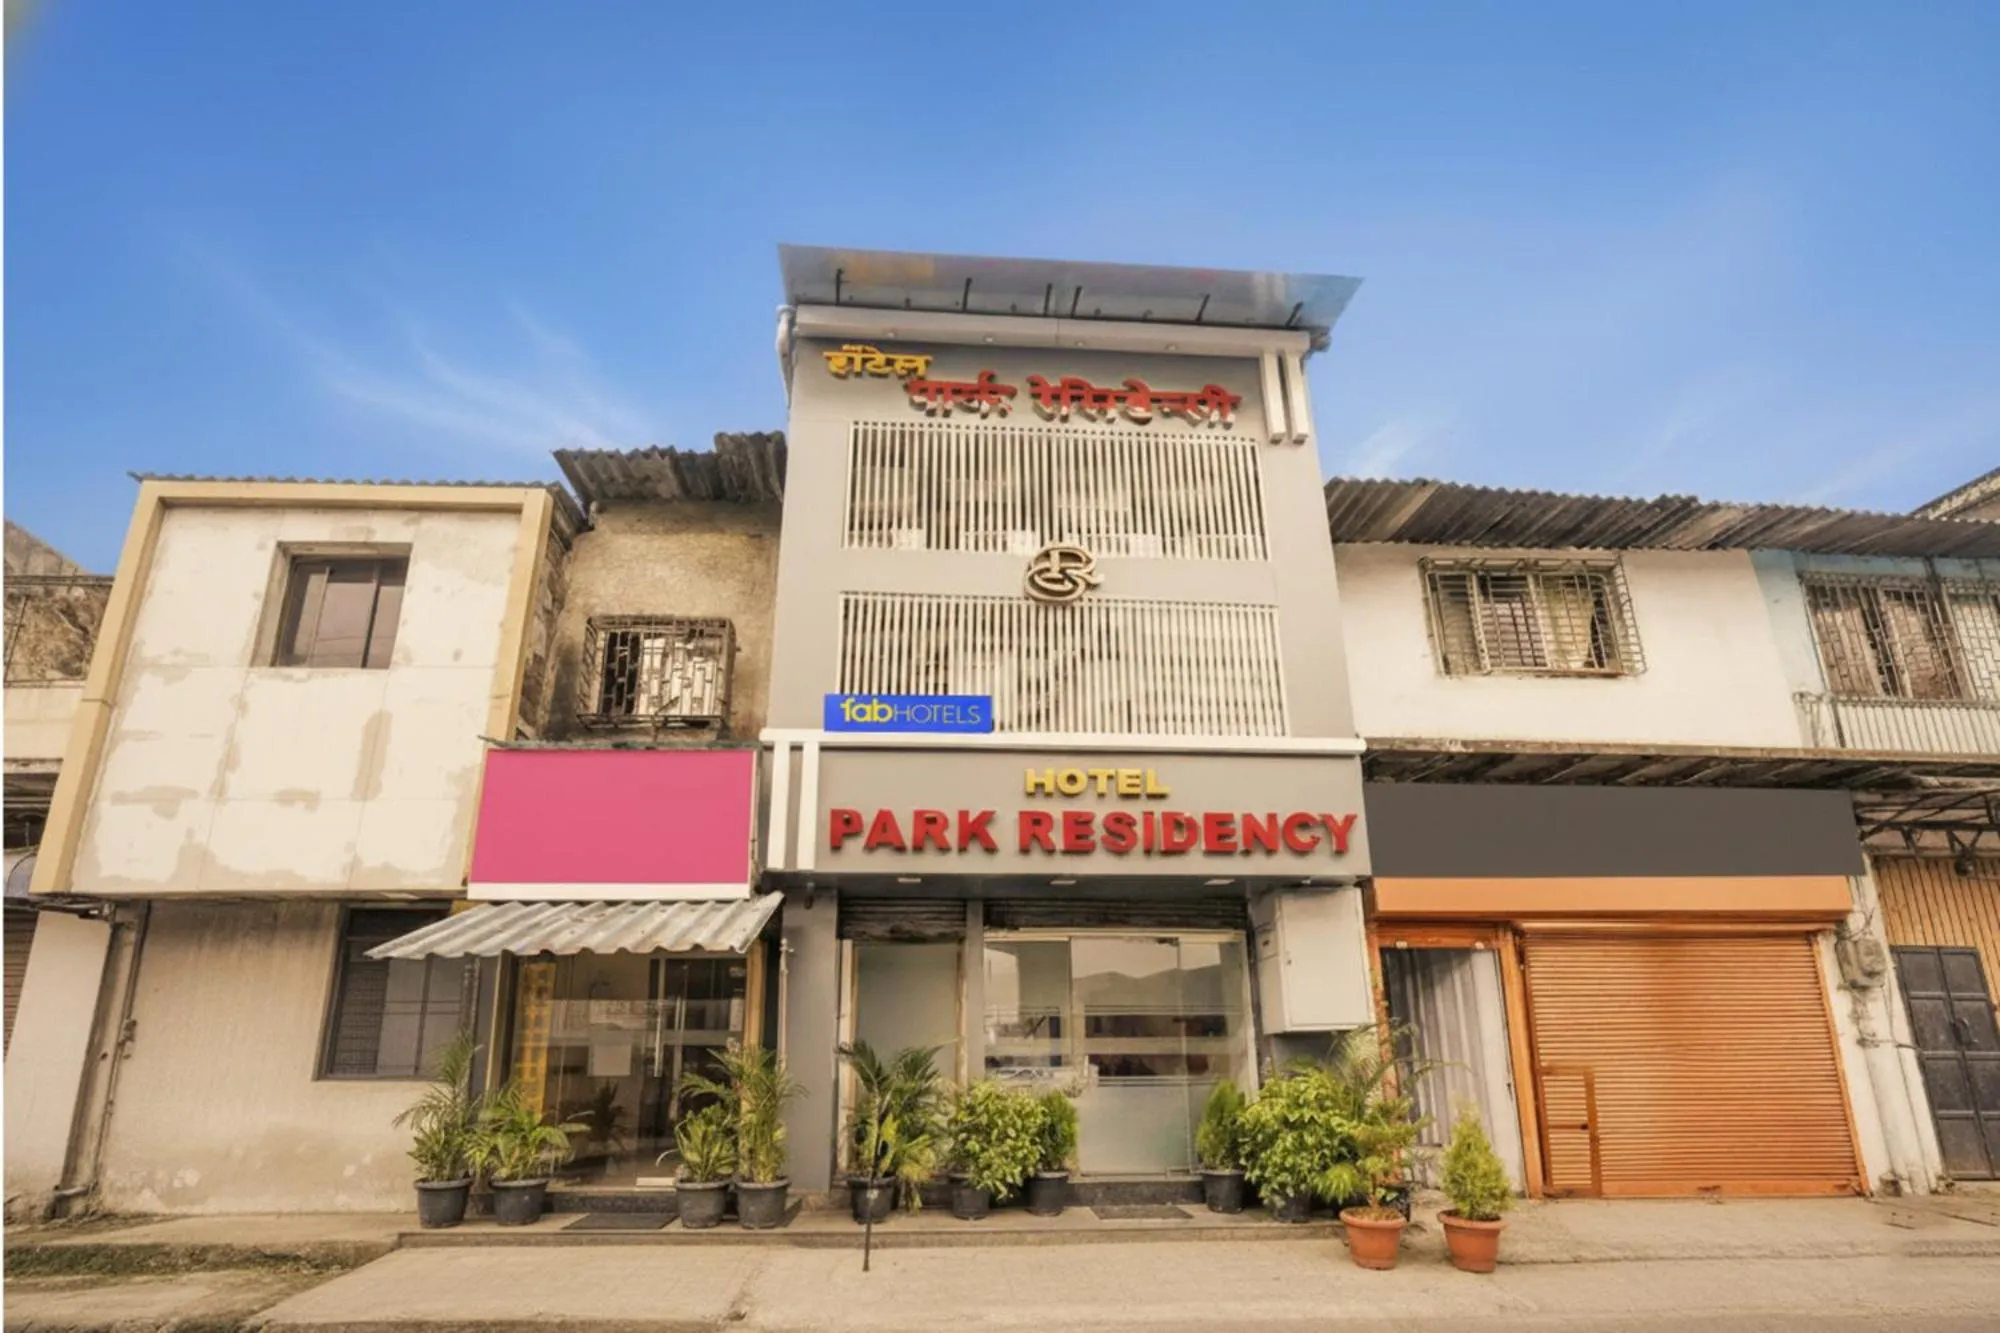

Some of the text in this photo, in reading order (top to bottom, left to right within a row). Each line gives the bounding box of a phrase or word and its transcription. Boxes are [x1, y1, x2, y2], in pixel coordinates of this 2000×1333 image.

[904, 370, 1018, 417] पार्क
[840, 697, 981, 725] fabHOTELS
[1025, 768, 1170, 797] HOTEL
[829, 809, 1357, 855] PARK RESIDENCY
